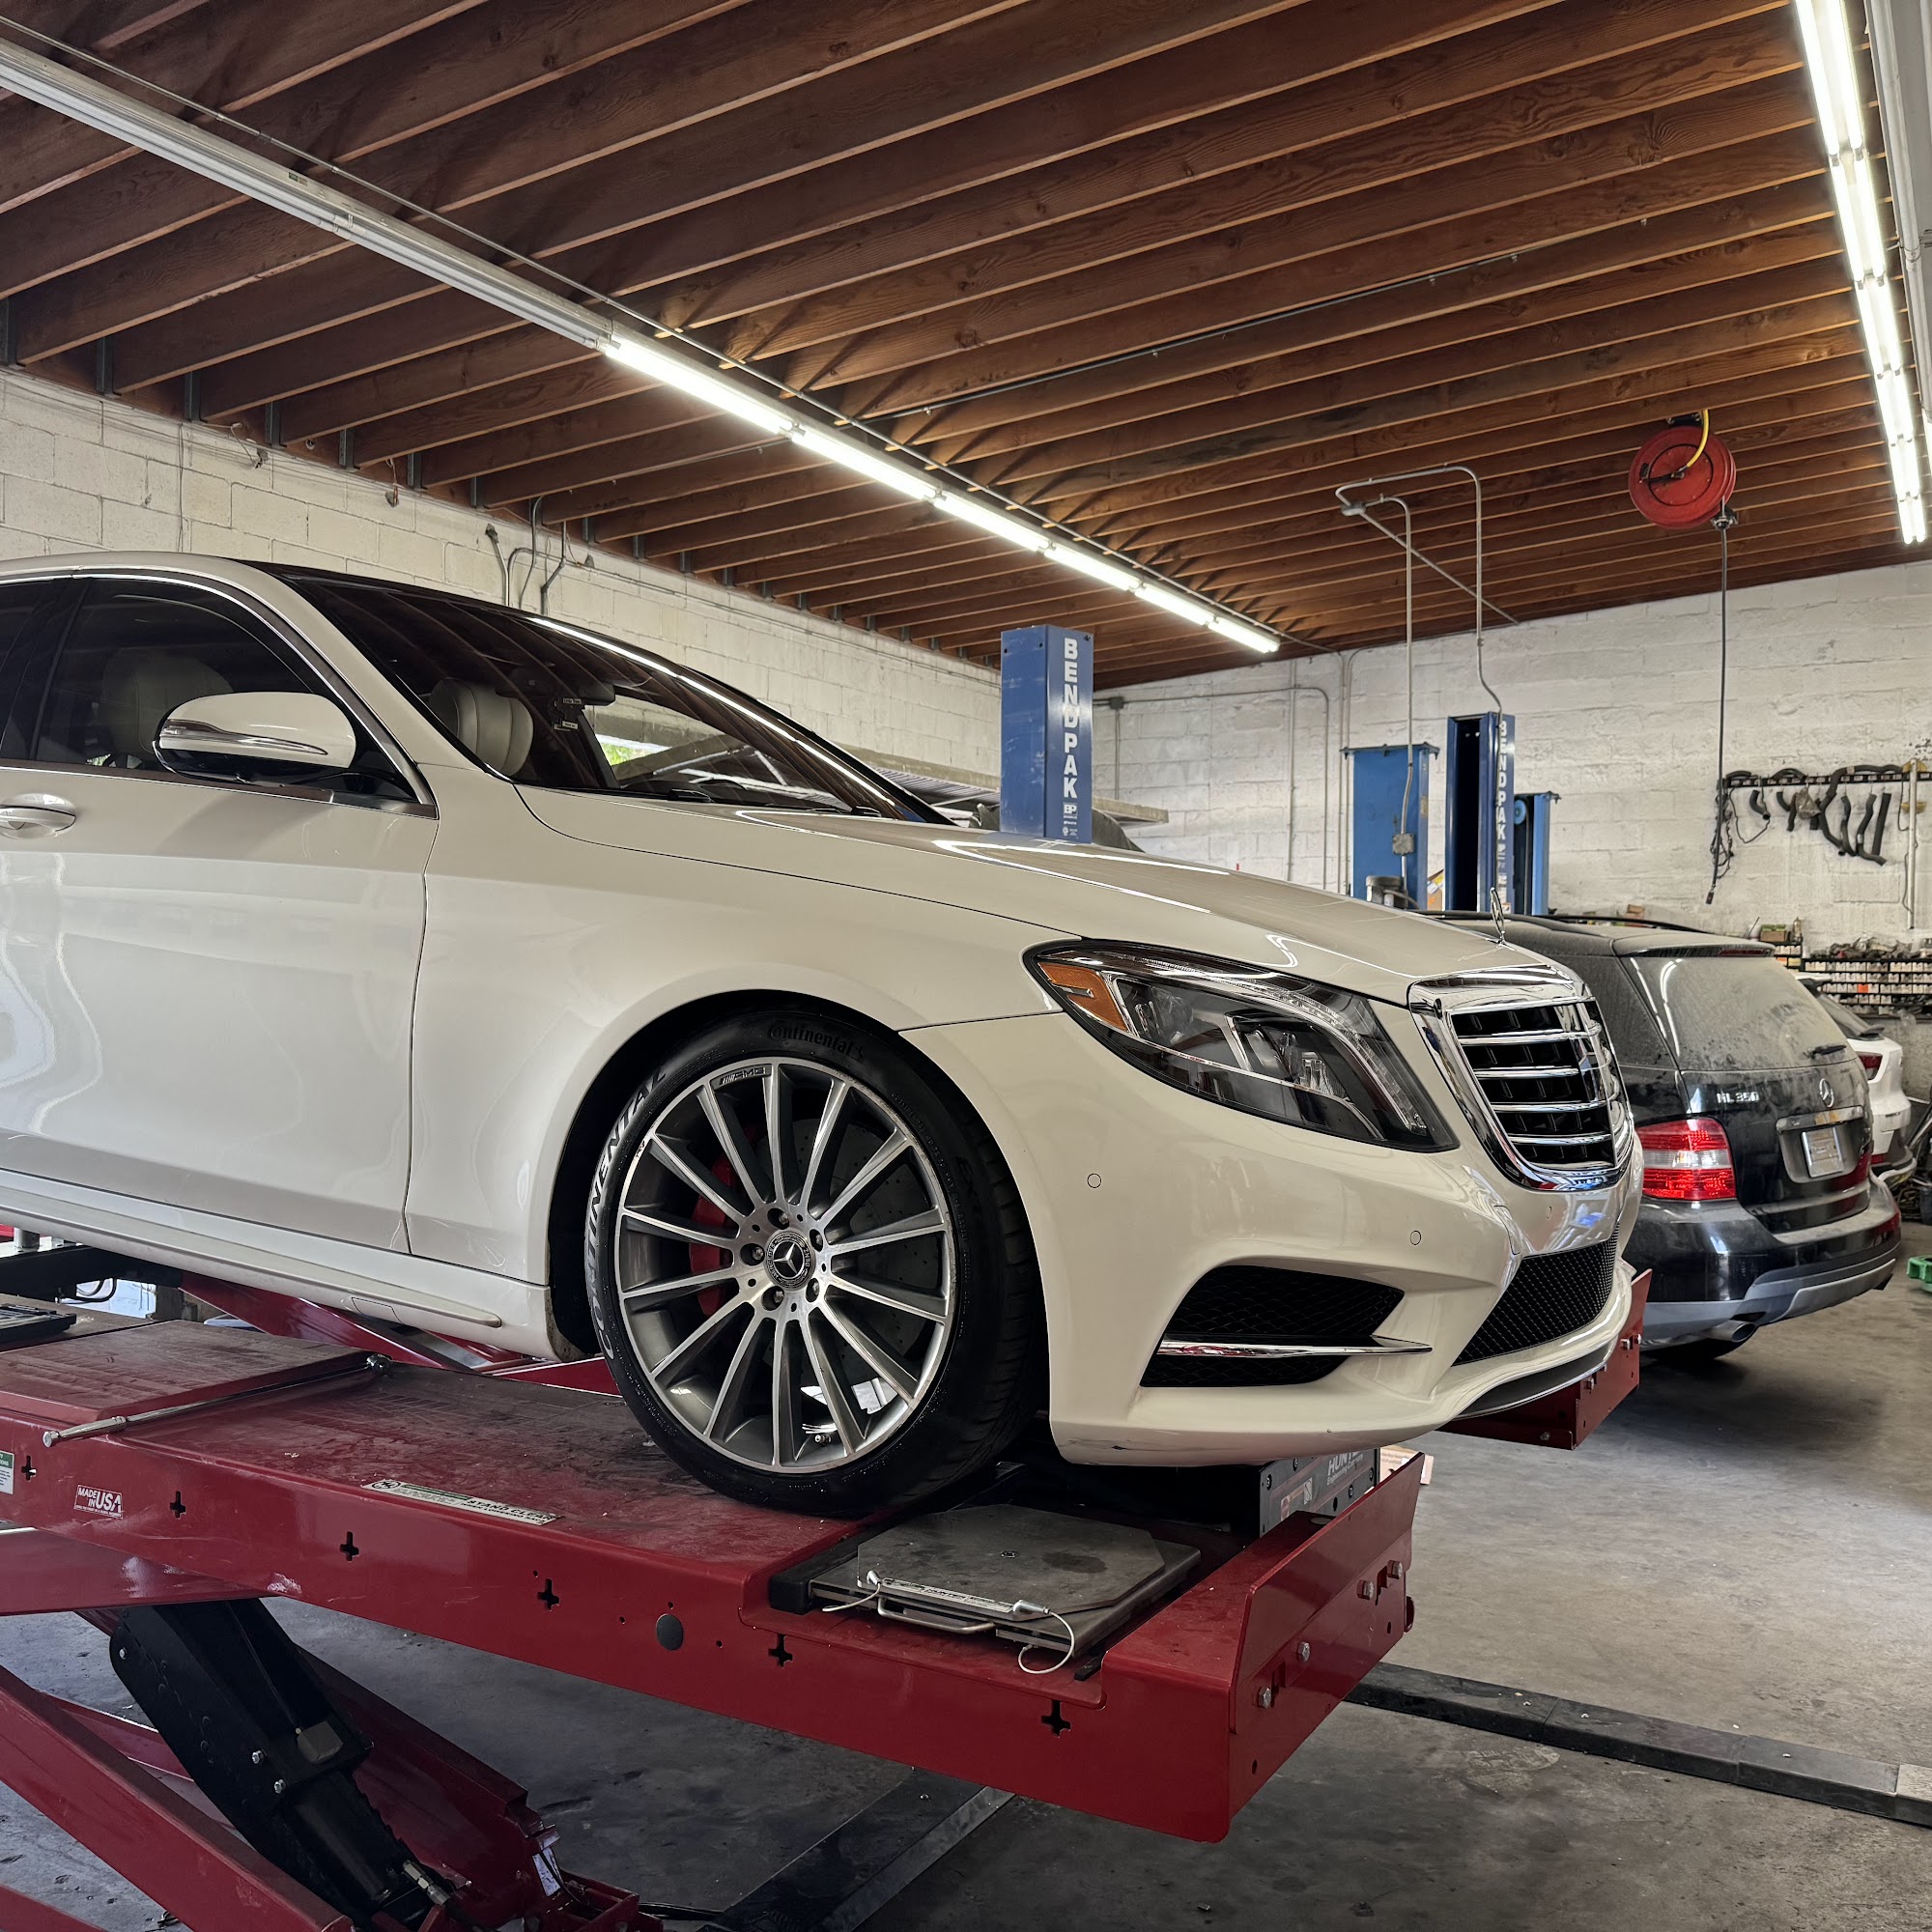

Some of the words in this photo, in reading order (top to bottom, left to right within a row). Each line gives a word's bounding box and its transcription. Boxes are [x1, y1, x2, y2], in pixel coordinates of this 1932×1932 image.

[1064, 638, 1078, 799] BENDPAK
[1498, 720, 1508, 840] BENDPAK
[587, 1069, 667, 1360] CONTINENTAL
[77, 1488, 97, 1498] MADE
[88, 1498, 96, 1507] IN
[96, 1491, 122, 1513] USA
[467, 1500, 509, 1511] STAND
